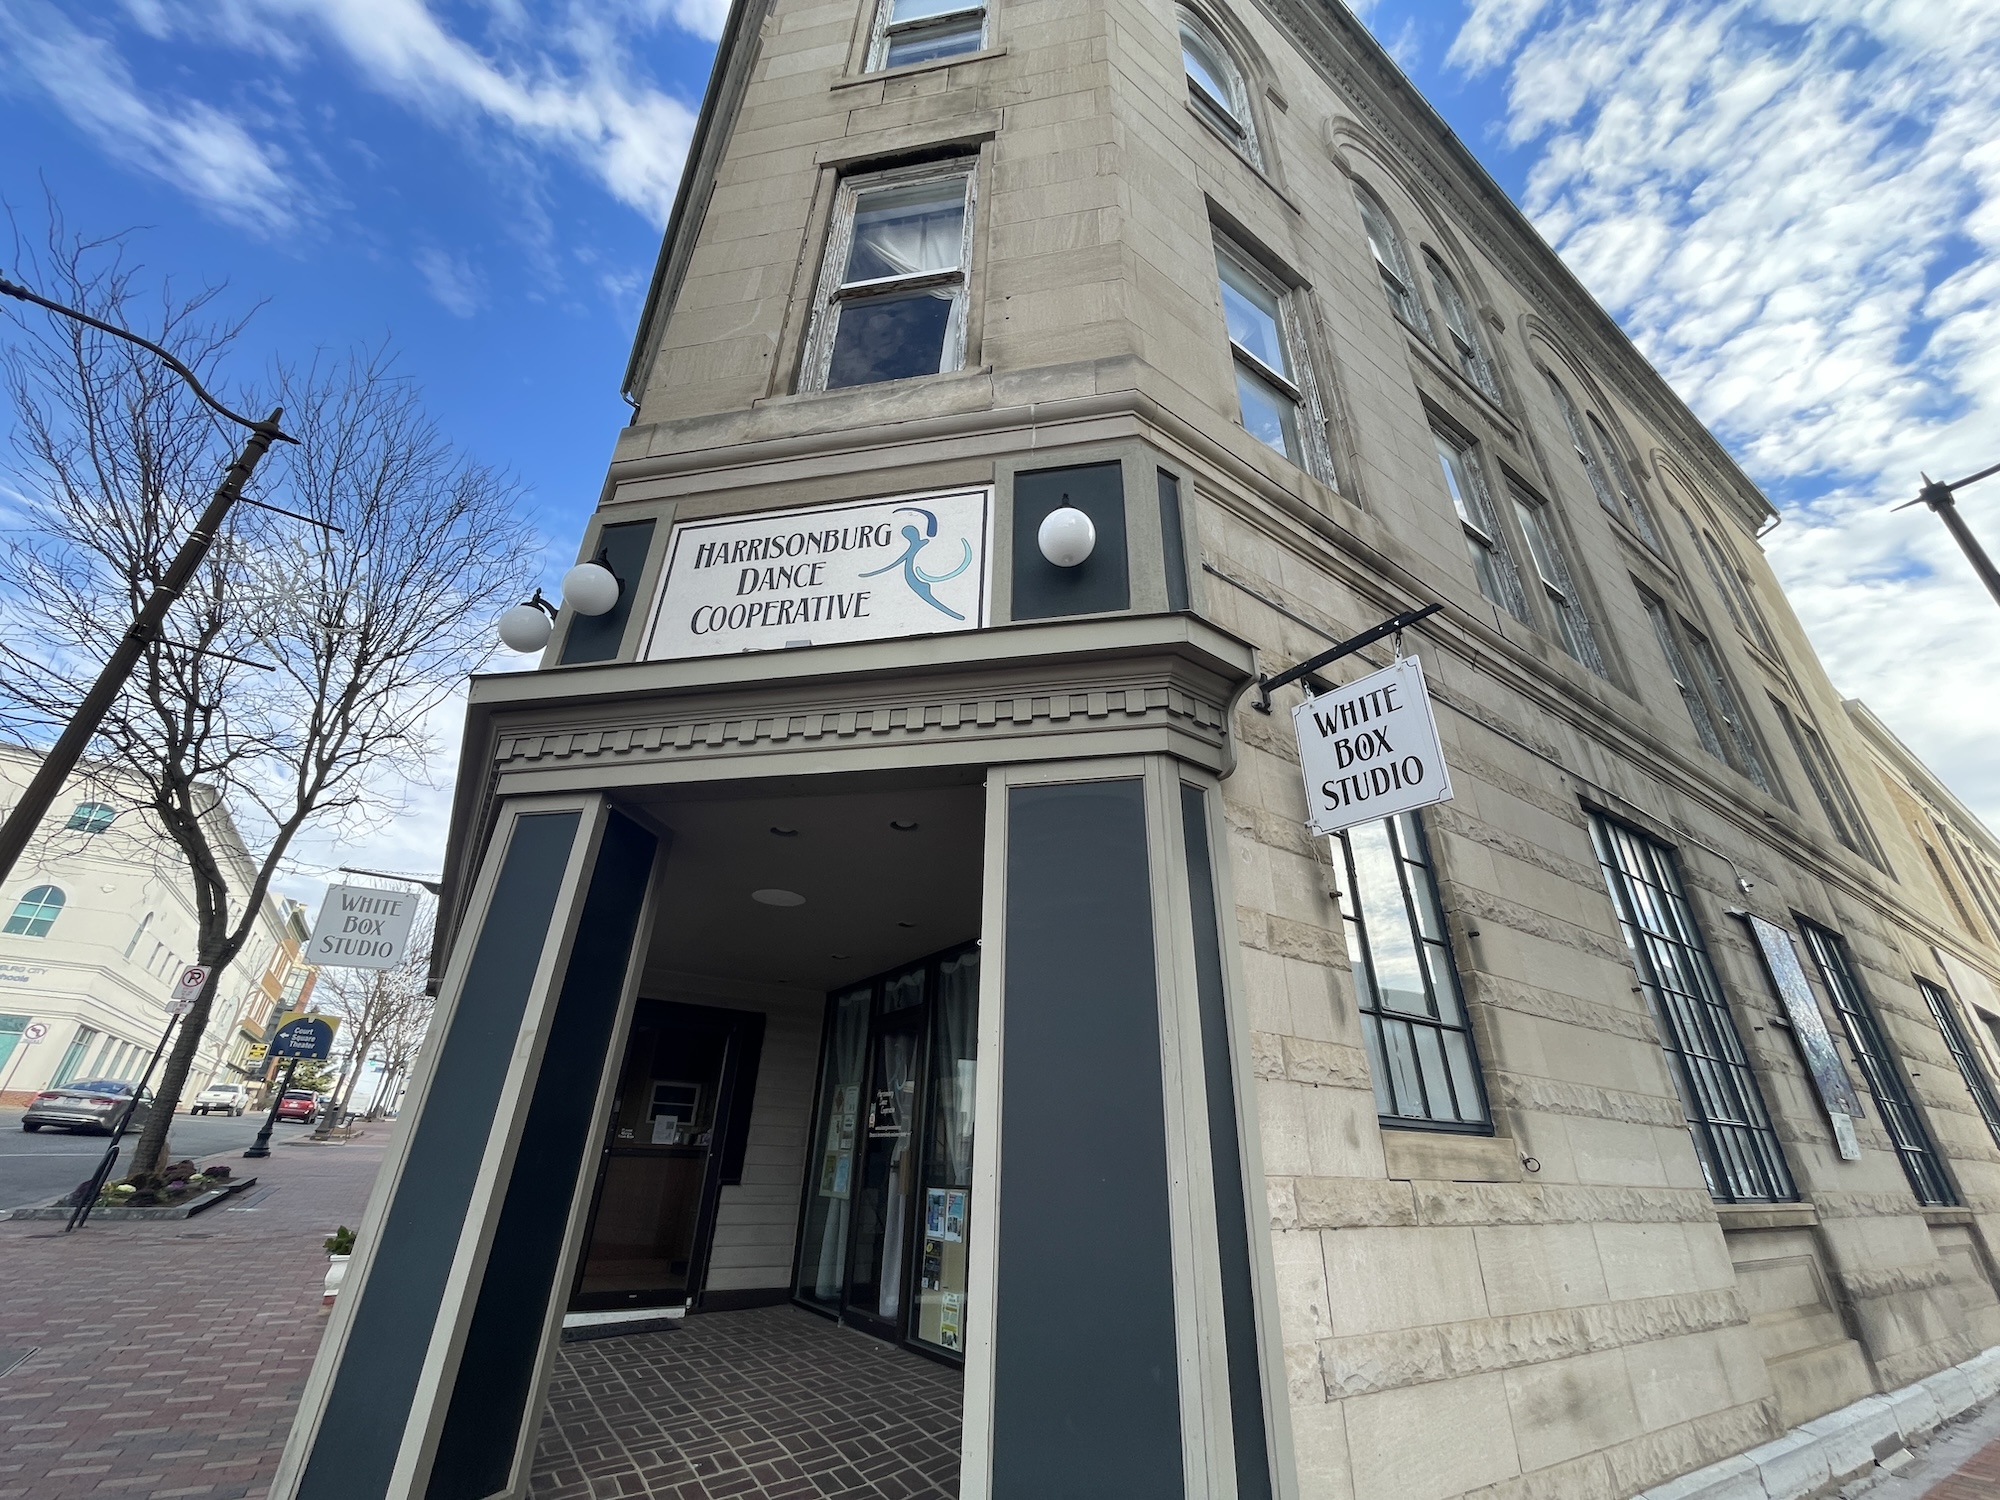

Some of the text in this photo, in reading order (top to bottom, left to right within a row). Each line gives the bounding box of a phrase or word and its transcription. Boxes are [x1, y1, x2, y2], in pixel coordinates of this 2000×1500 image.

[693, 523, 892, 570] HARRISONBURG
[736, 561, 827, 596] DANCE
[690, 591, 871, 635] COOPERATIVE
[1313, 683, 1404, 738] WHITE
[1334, 725, 1394, 770] BOX
[1321, 755, 1424, 811] STUDIO
[341, 893, 403, 917] WHITE
[342, 915, 386, 936] BOX
[319, 935, 393, 958] STUDIO
[0, 973, 29, 982] hools
[27, 967, 49, 975] CITY
[291, 1034, 316, 1042] Square
[294, 1027, 314, 1035] Court
[289, 1040, 316, 1049] Theater
